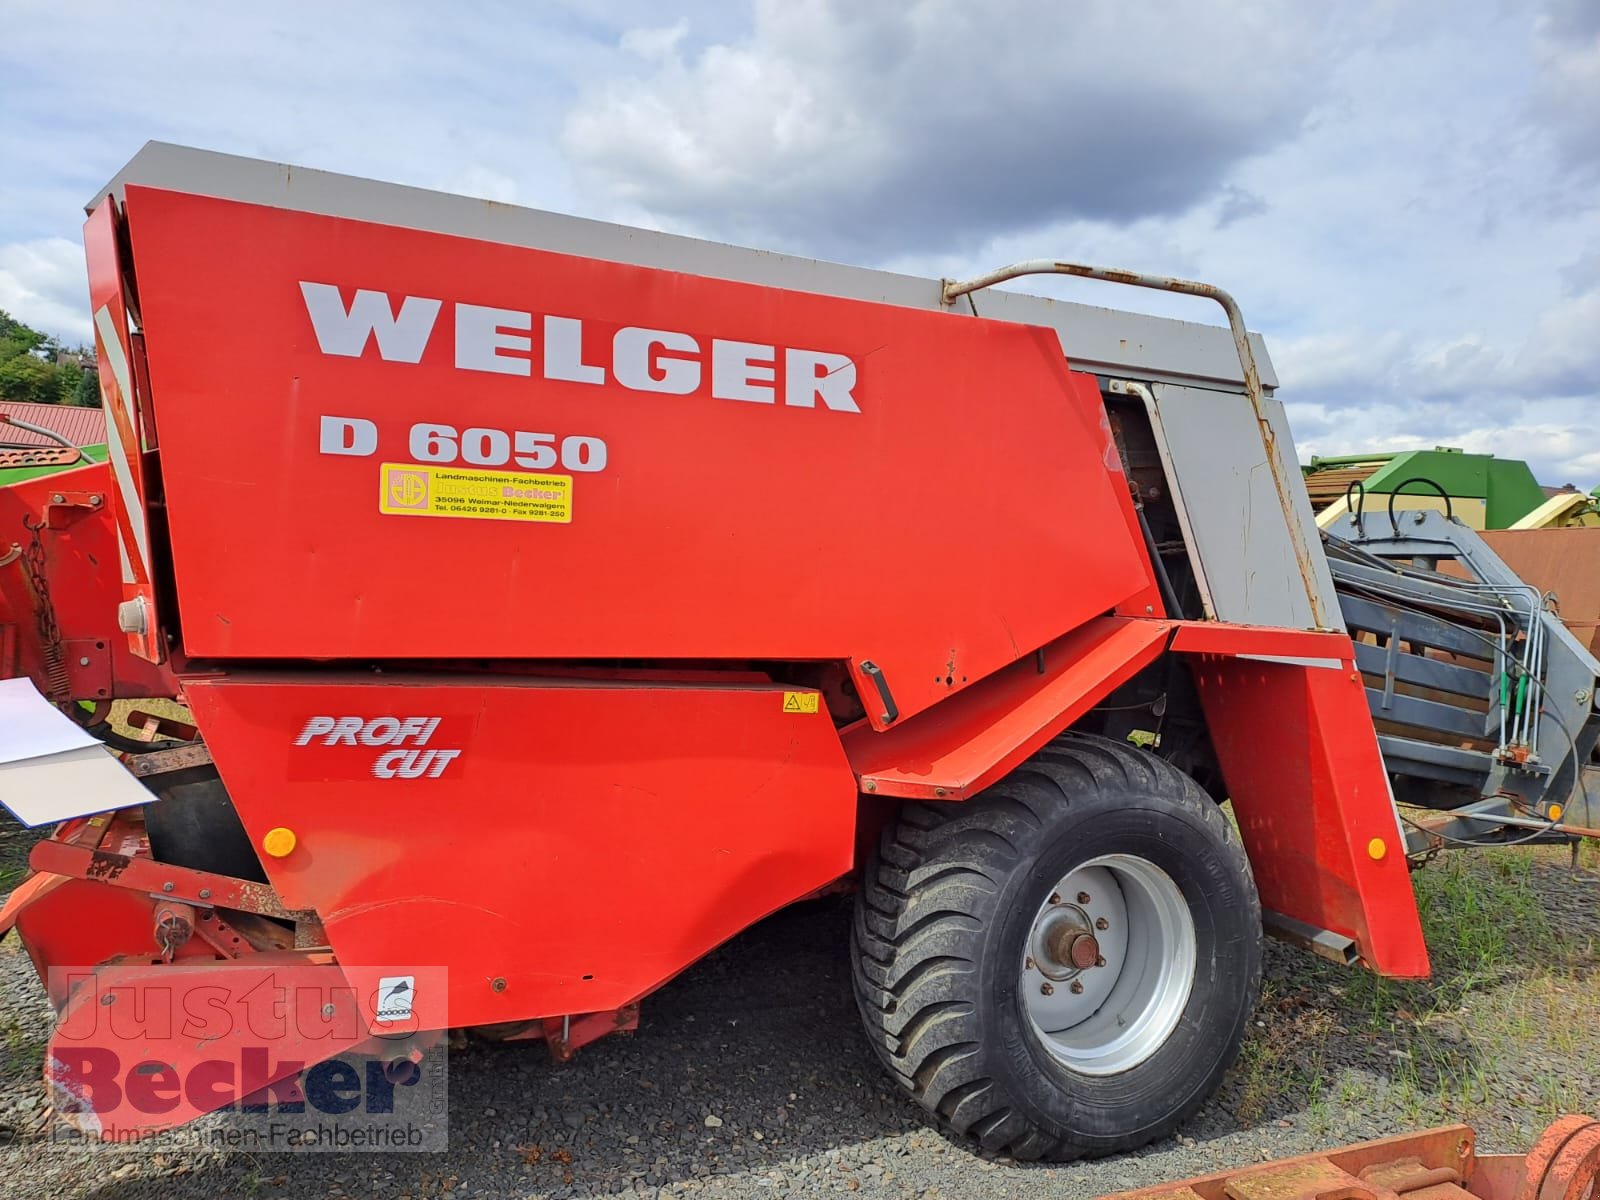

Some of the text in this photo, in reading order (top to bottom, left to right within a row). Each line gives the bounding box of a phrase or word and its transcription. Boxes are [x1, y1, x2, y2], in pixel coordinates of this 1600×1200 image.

[299, 280, 862, 413] WELGER
[319, 415, 608, 472] D 6050
[435, 472, 566, 487] Landmaschinen-Fachbetrieb
[435, 496, 465, 504] 35096
[502, 486, 562, 500] Becker
[450, 505, 478, 513] 06426
[292, 716, 442, 746] PROFI
[370, 749, 462, 778] CUT
